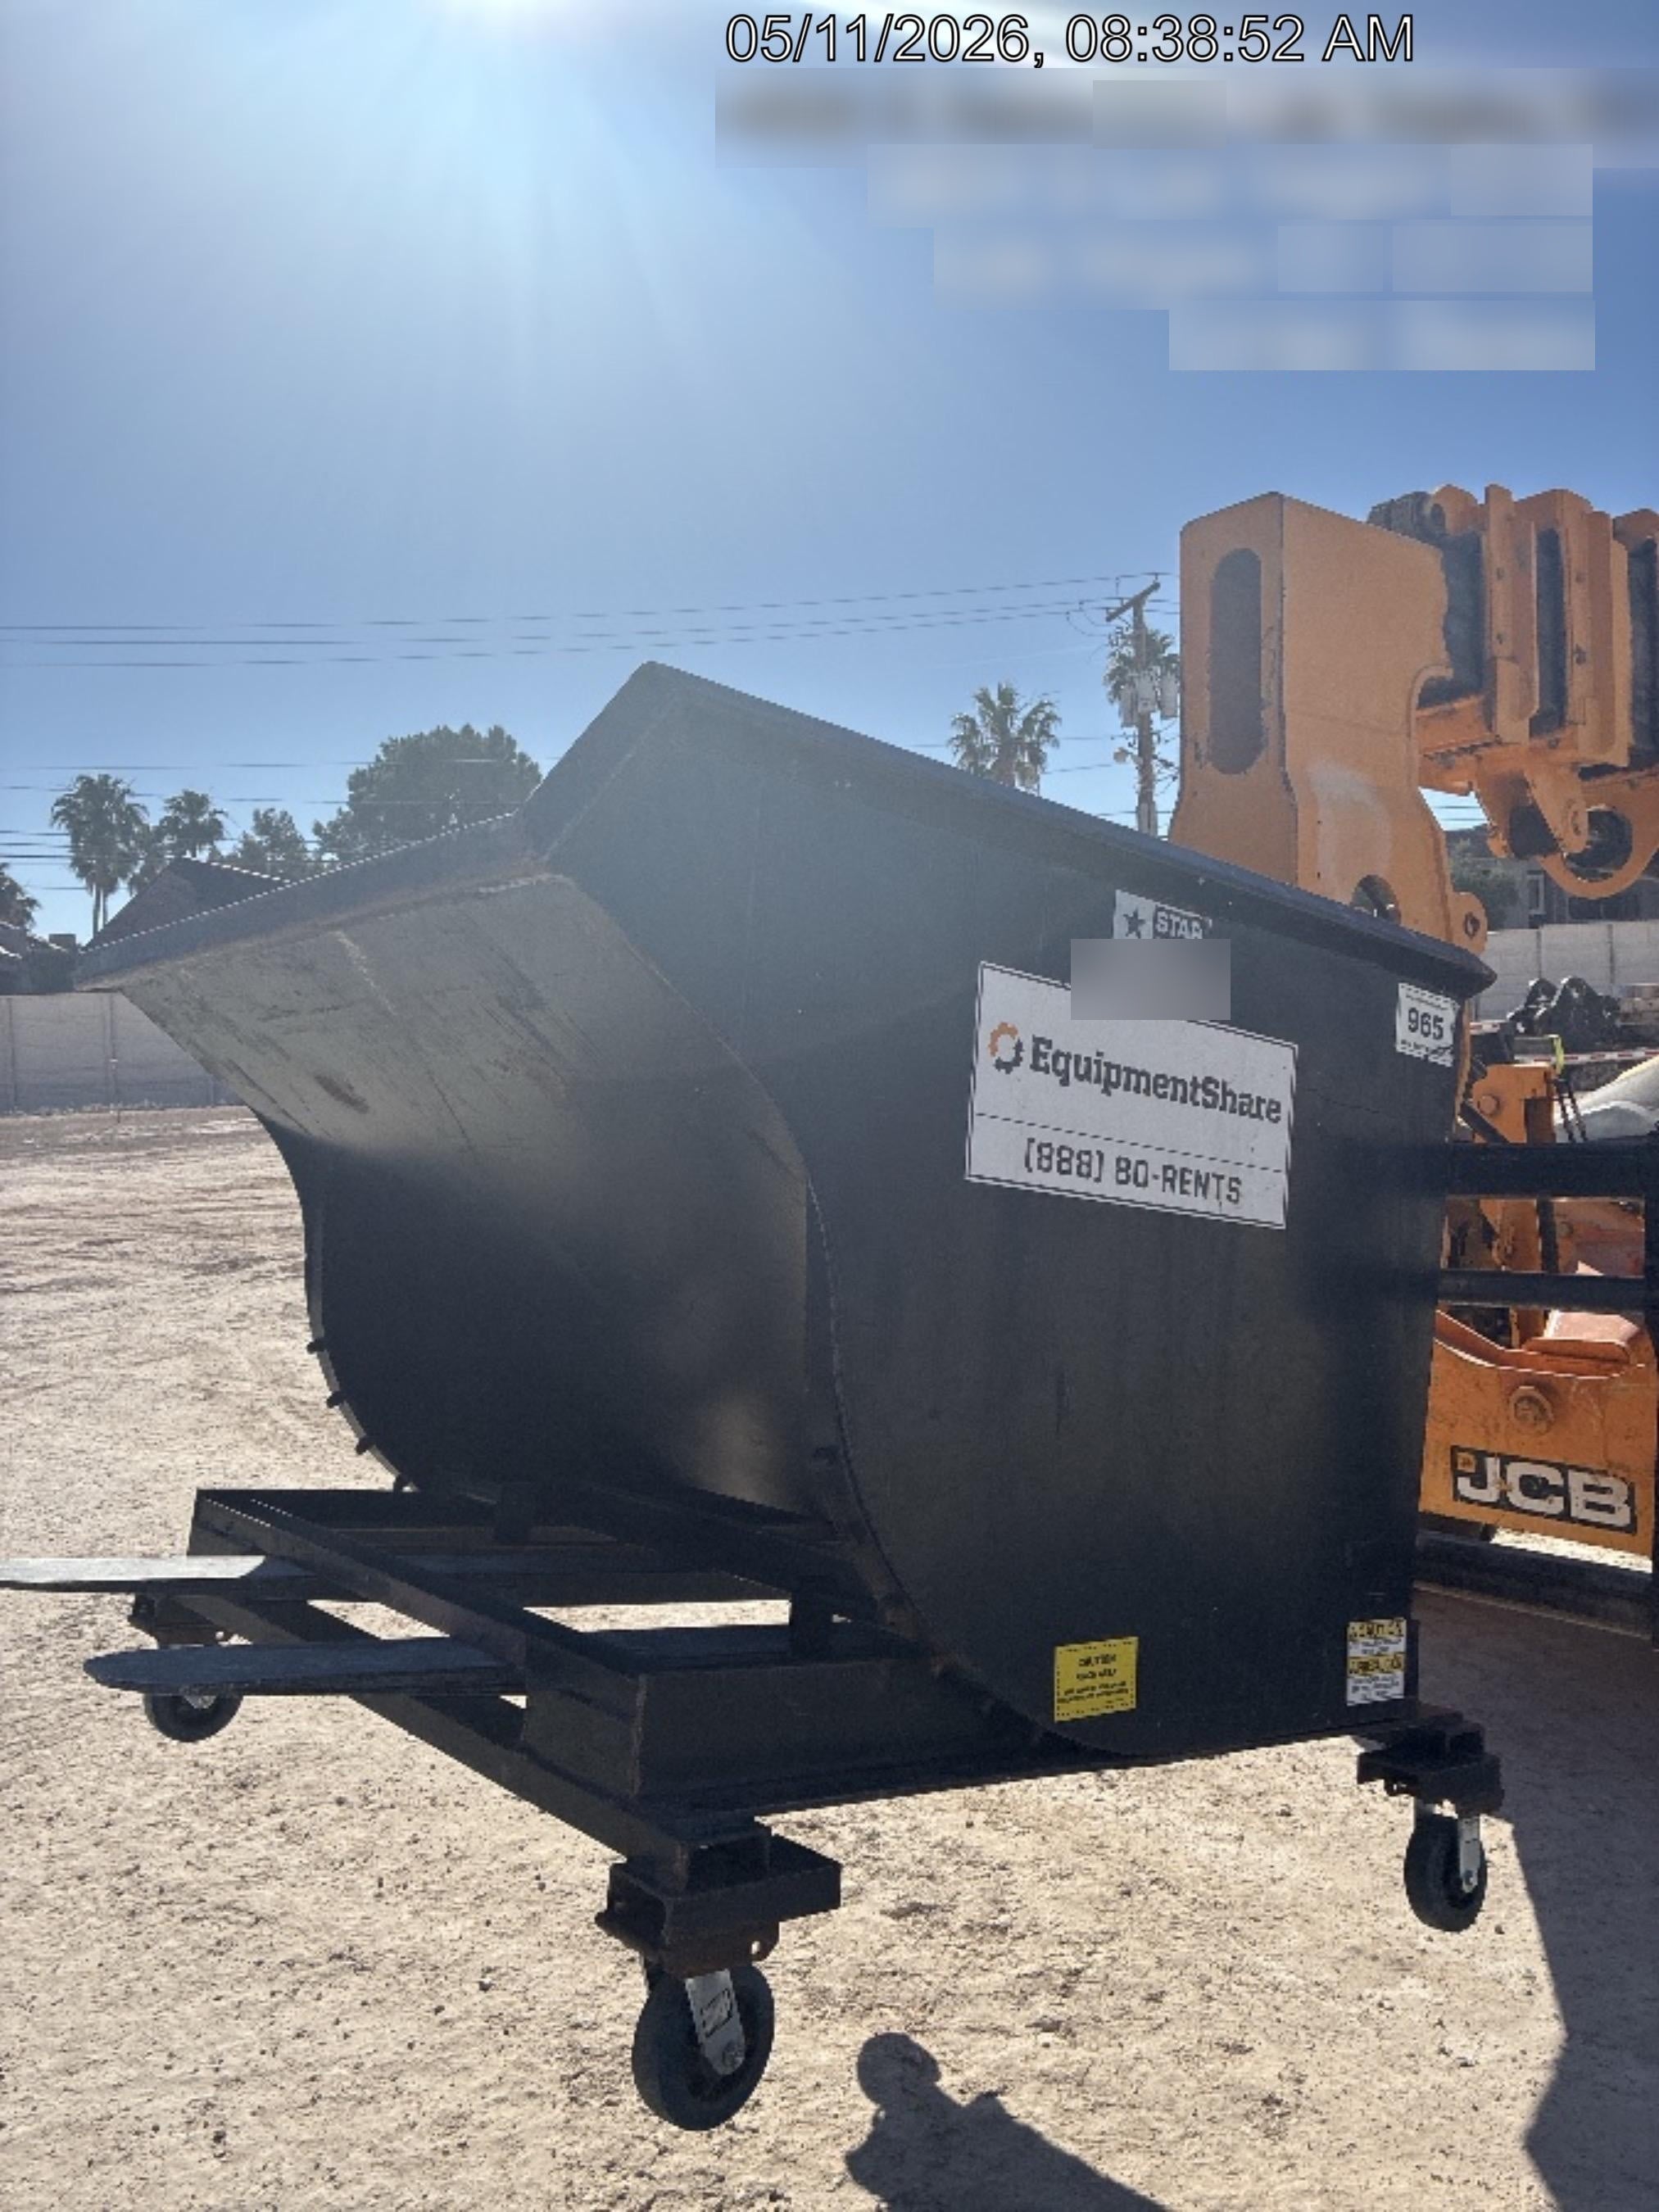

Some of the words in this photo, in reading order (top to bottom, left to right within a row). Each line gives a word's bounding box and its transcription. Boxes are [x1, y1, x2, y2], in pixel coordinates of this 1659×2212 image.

[1408, 1007, 1444, 1040] 965
[1029, 1034, 1281, 1123] EquipmentShare
[1115, 1155, 1243, 1204] 80-RENTS
[1457, 1457, 1631, 1527] JCB
